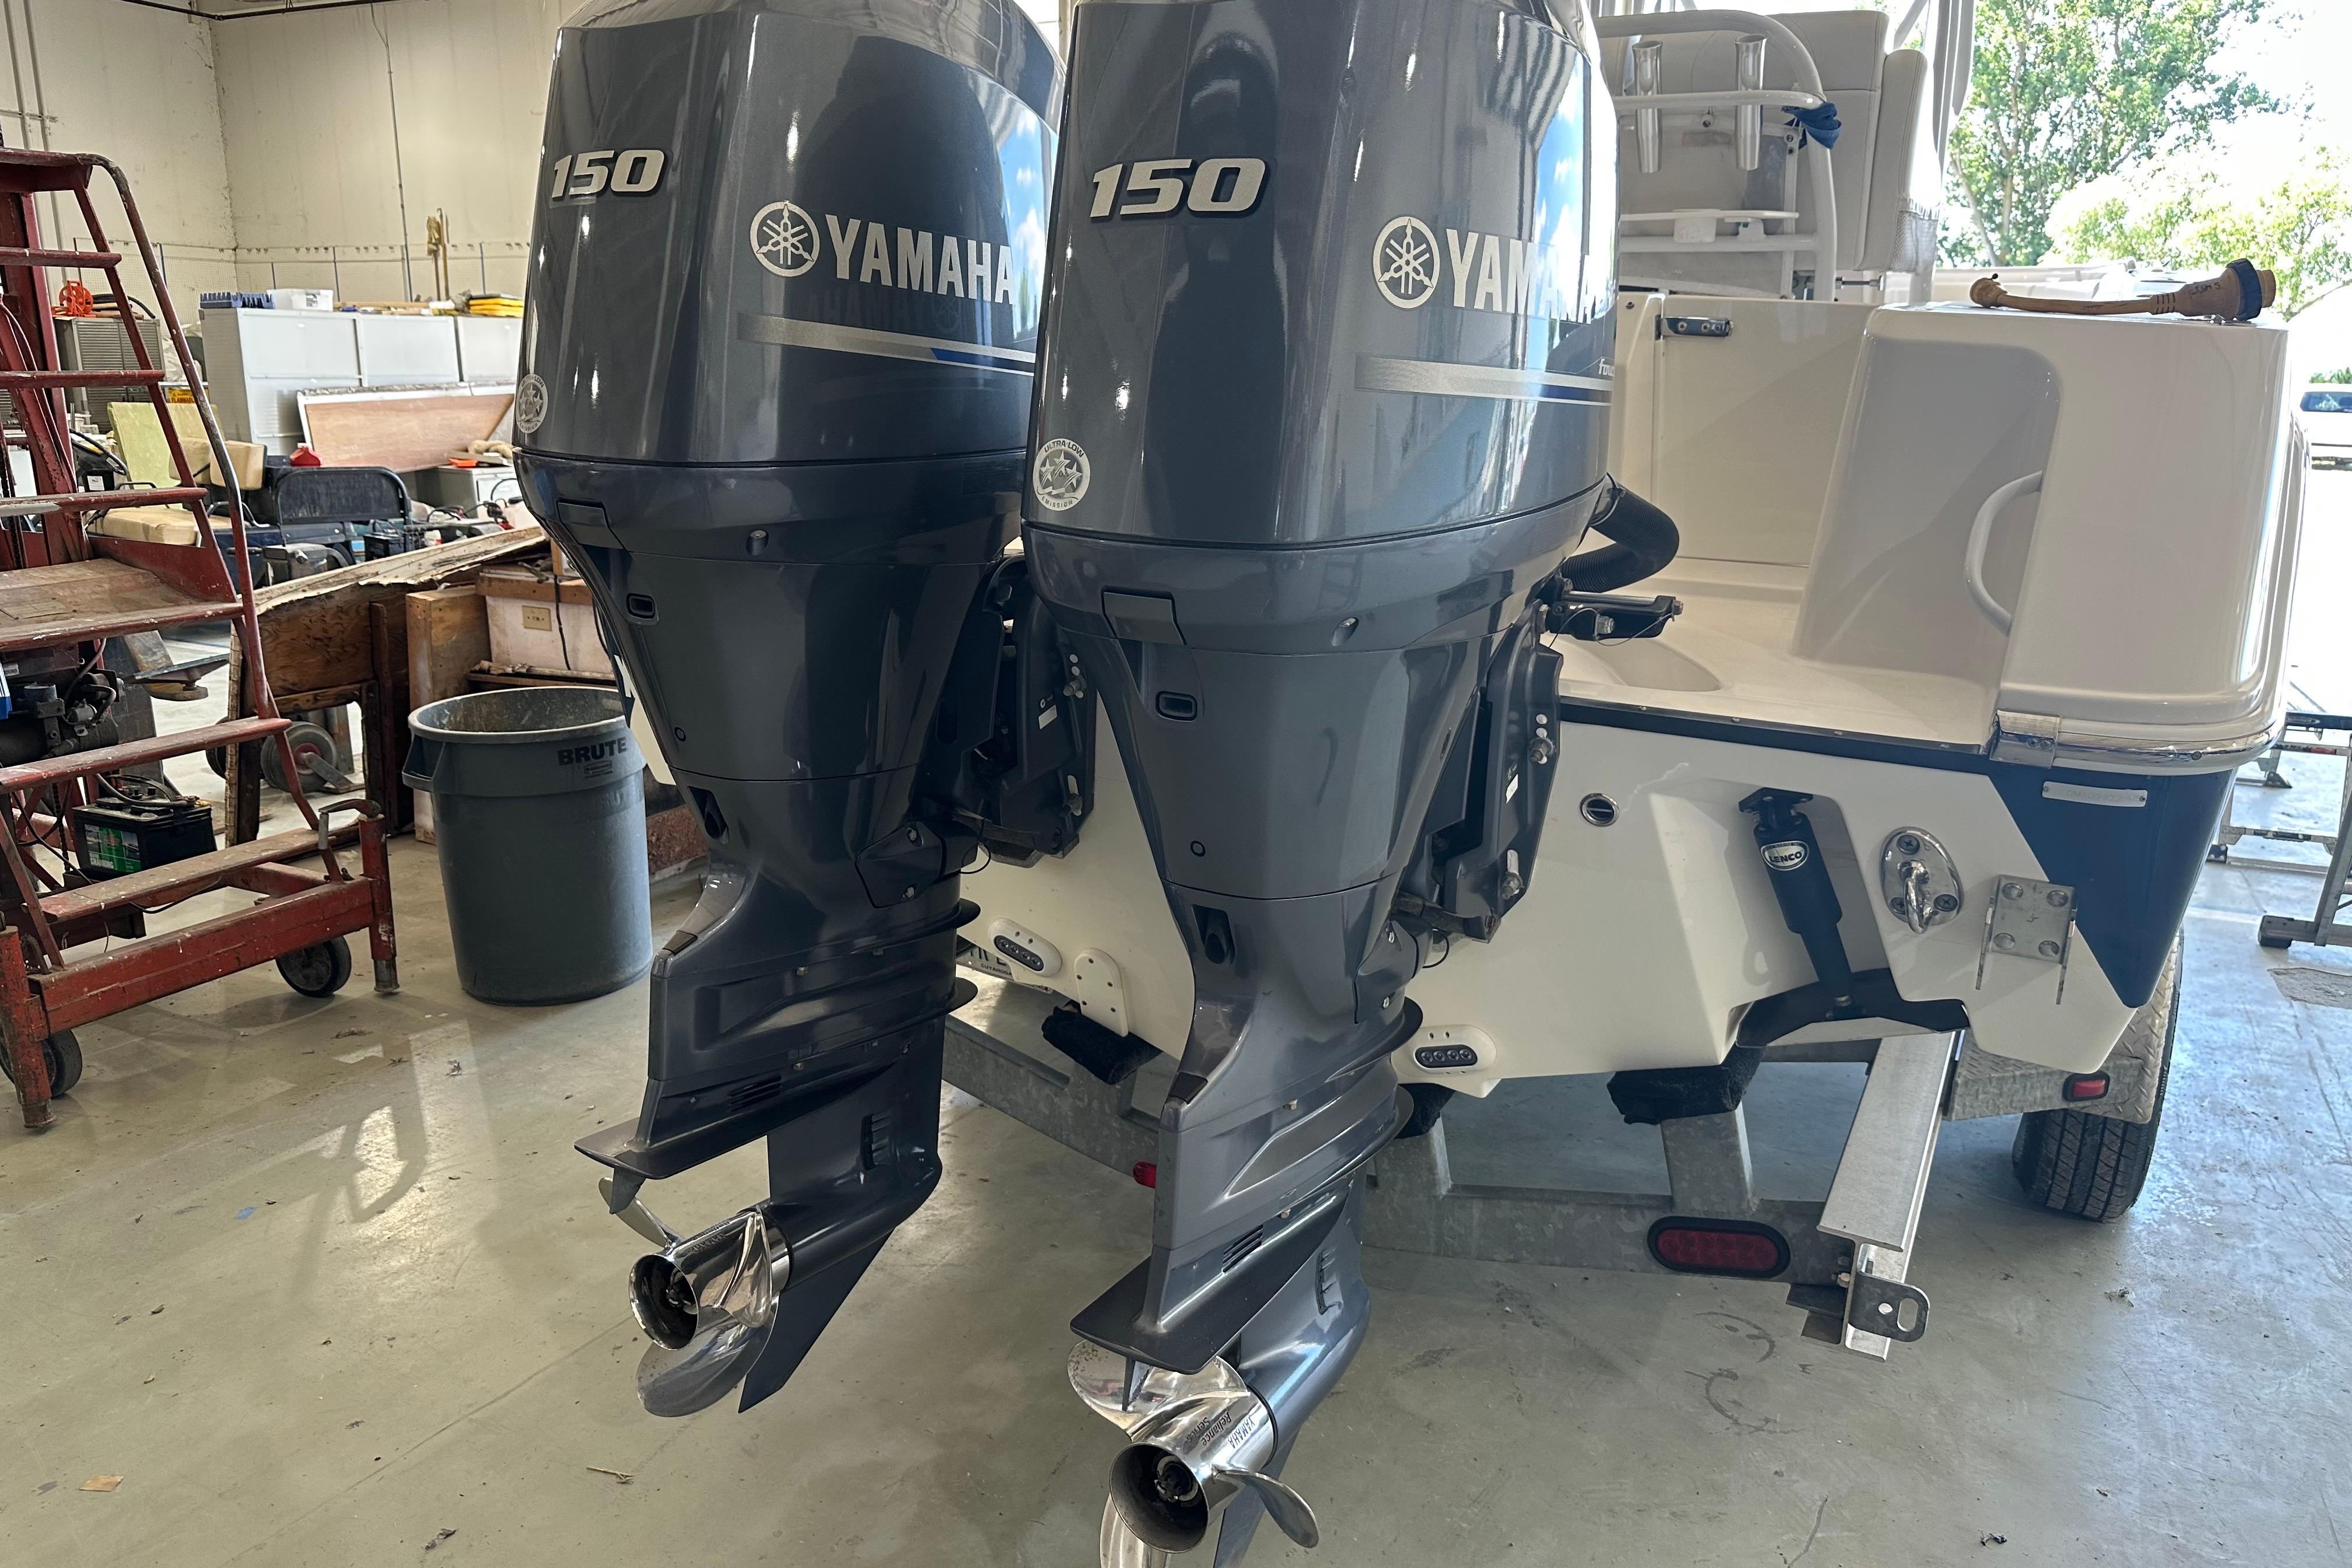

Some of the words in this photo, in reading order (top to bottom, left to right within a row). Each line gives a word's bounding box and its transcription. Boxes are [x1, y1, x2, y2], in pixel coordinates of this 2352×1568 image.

[552, 149, 666, 200] 150
[1090, 158, 1265, 218] 150
[824, 214, 1016, 305] YAMAHA
[1446, 228, 1592, 325] YAMAA
[1041, 495, 1073, 508] EMISSION
[558, 736, 627, 766] BRUTE
[1769, 851, 1802, 862] LENCO
[981, 963, 1012, 975] CUYAHOGA
[1186, 1417, 1210, 1442] Series
[1201, 1412, 1232, 1446] Reliance
[1227, 1416, 1256, 1449] YAMAHA
